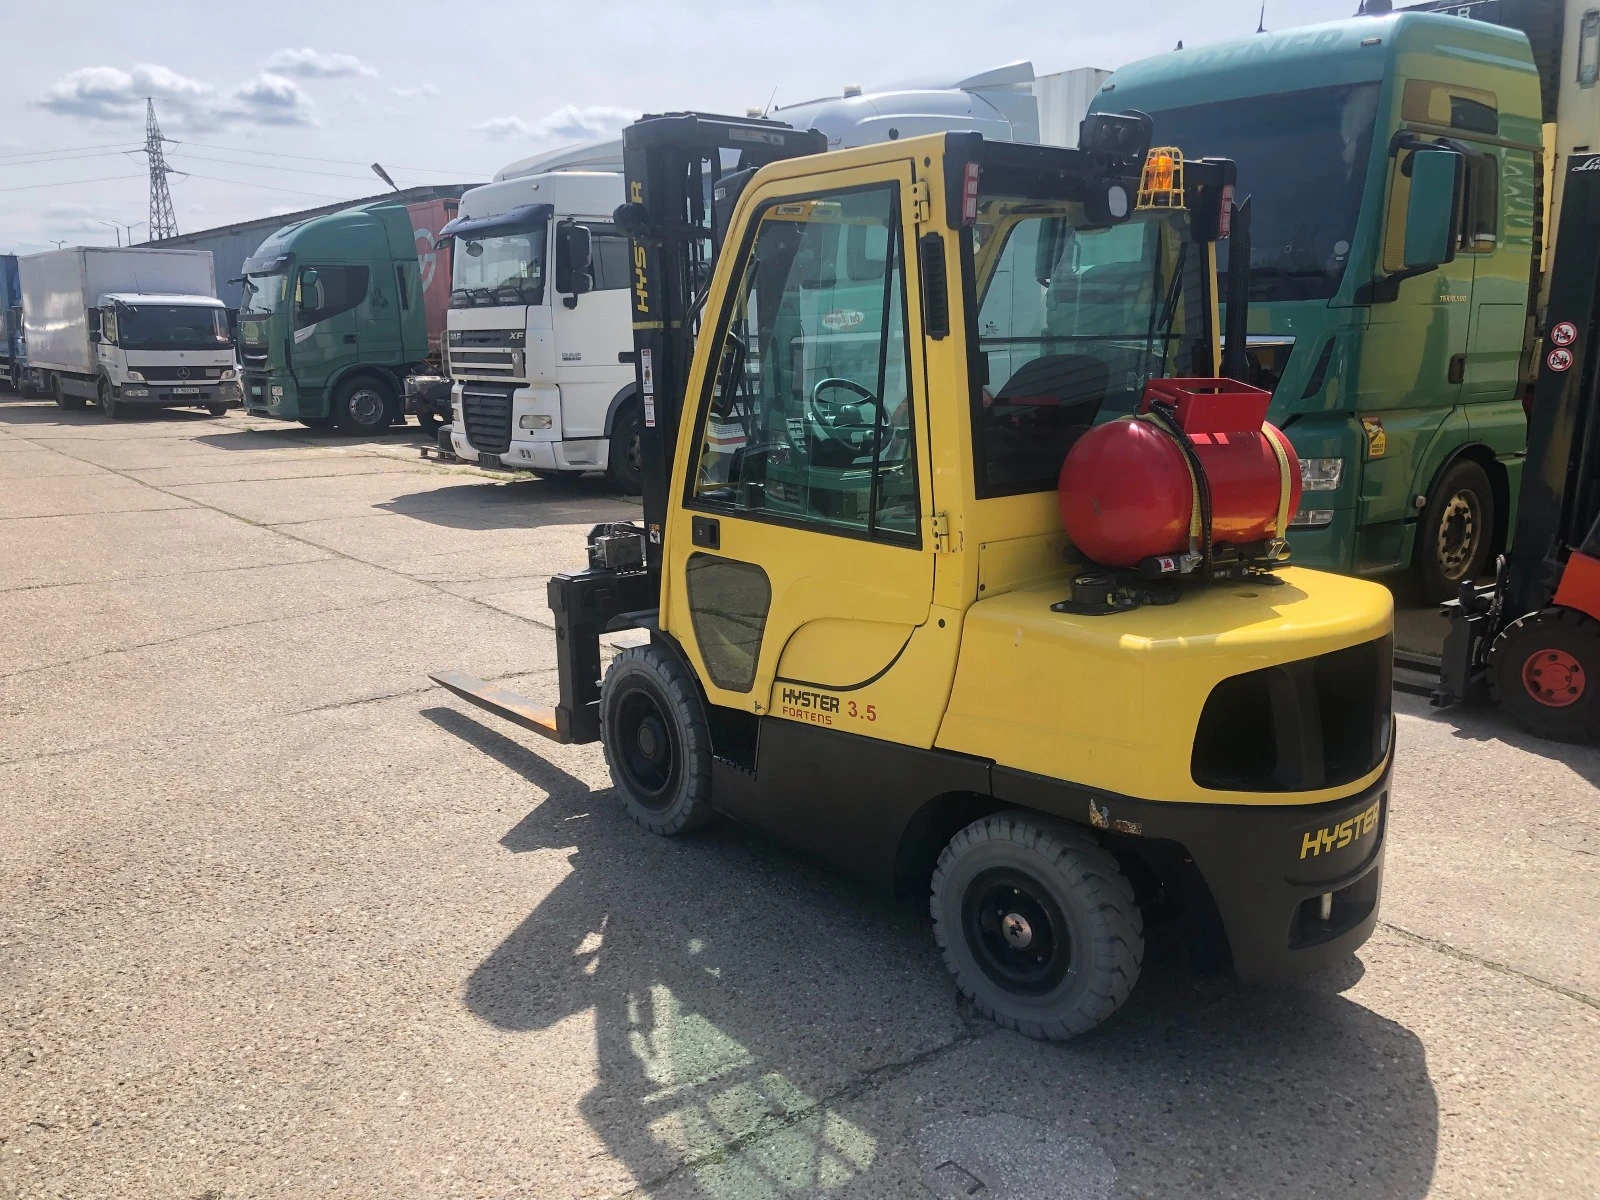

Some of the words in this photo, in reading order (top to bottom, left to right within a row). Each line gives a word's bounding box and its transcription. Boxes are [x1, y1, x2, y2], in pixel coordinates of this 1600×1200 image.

[630, 180, 649, 313] HYSR
[508, 332, 524, 340] XF
[782, 687, 840, 714] HYSTER
[847, 700, 877, 722] 3.5
[782, 706, 833, 726] FORTENS
[1299, 799, 1380, 860] HYSTER
